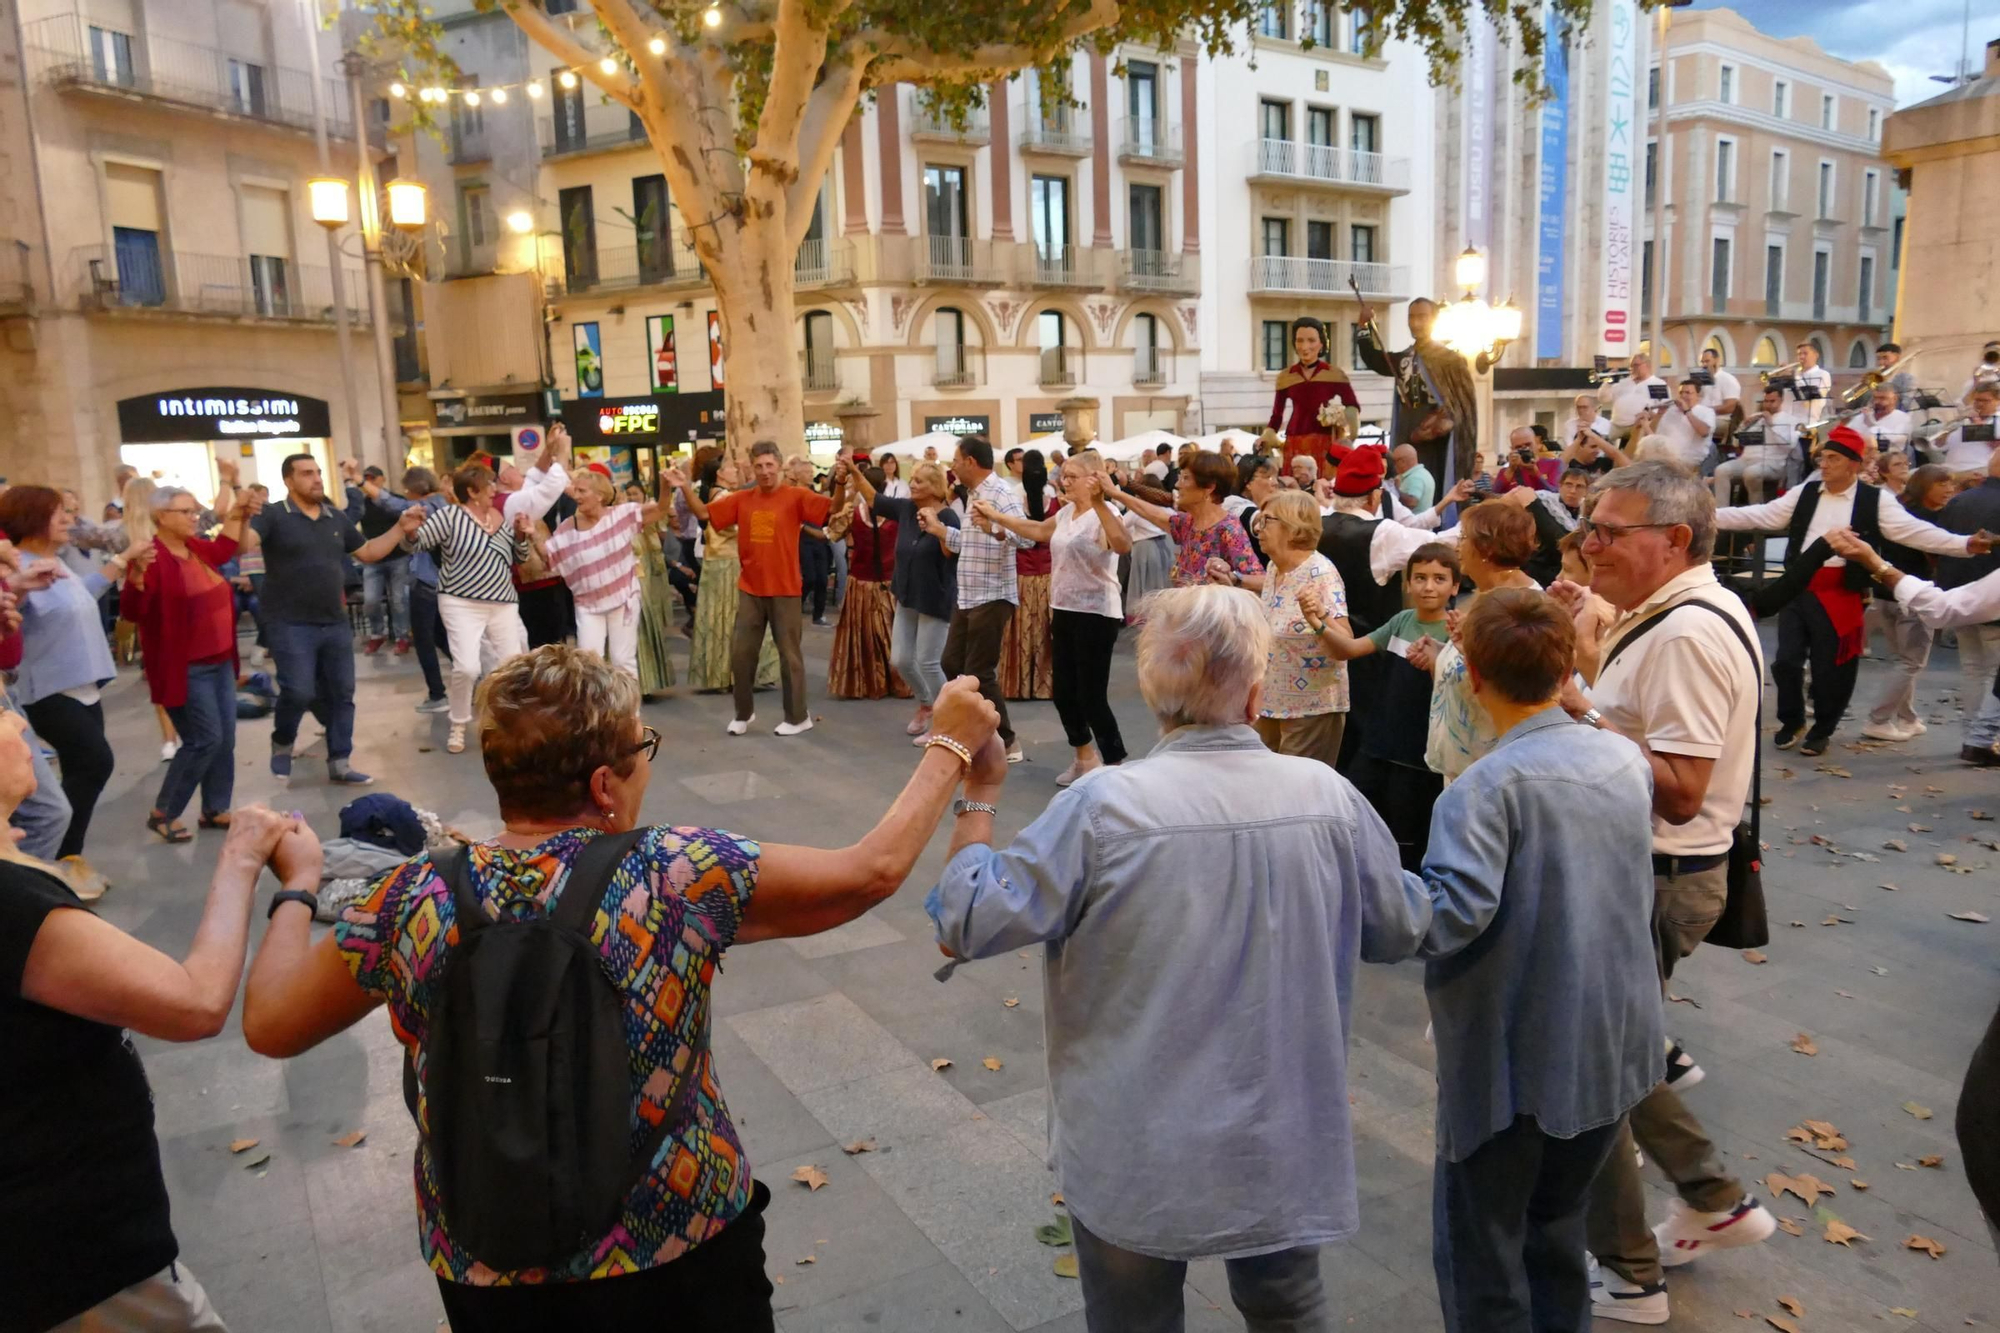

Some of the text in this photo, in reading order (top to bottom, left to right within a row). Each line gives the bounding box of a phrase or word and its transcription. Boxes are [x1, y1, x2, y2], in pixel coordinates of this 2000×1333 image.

[1607, 206, 1619, 299] HISTORIES
[546, 391, 562, 415] L
[613, 414, 657, 433] FPC
[1036, 419, 1064, 428] CANTO
